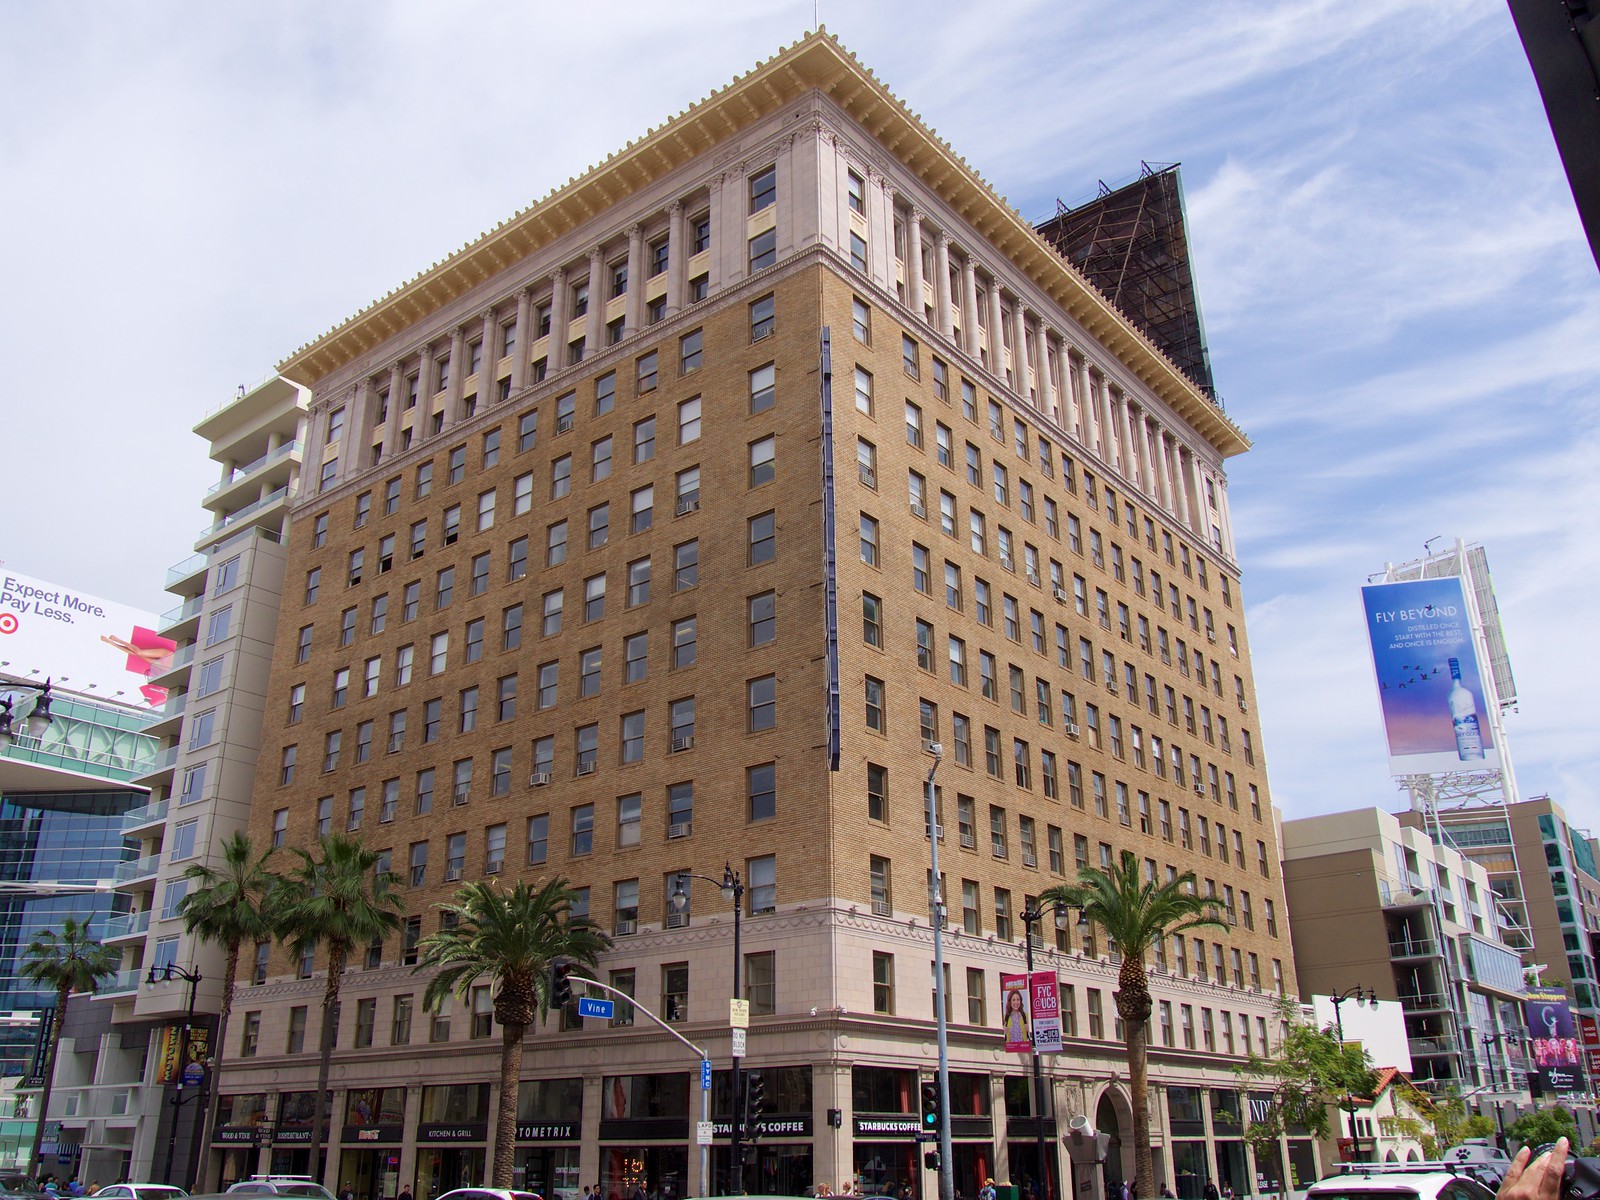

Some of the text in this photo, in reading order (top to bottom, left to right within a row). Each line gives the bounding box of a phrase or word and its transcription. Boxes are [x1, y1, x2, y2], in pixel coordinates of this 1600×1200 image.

[3, 577, 106, 618] Expect More.
[0, 592, 74, 624] Pay Less.
[1376, 606, 1456, 622] FLY BEYOND
[1408, 623, 1438, 631] DISTILLED
[1038, 986, 1051, 998] FYC
[588, 1003, 606, 1014] Vine
[1034, 997, 1056, 1009] @UCB
[1048, 1030, 1058, 1038] UCB
[164, 1026, 177, 1081] MOTOWN
[519, 1126, 571, 1138] TOMETRIX
[768, 1122, 804, 1132] COFFEE
[859, 1122, 921, 1131] STARBUCKS COFFEE
